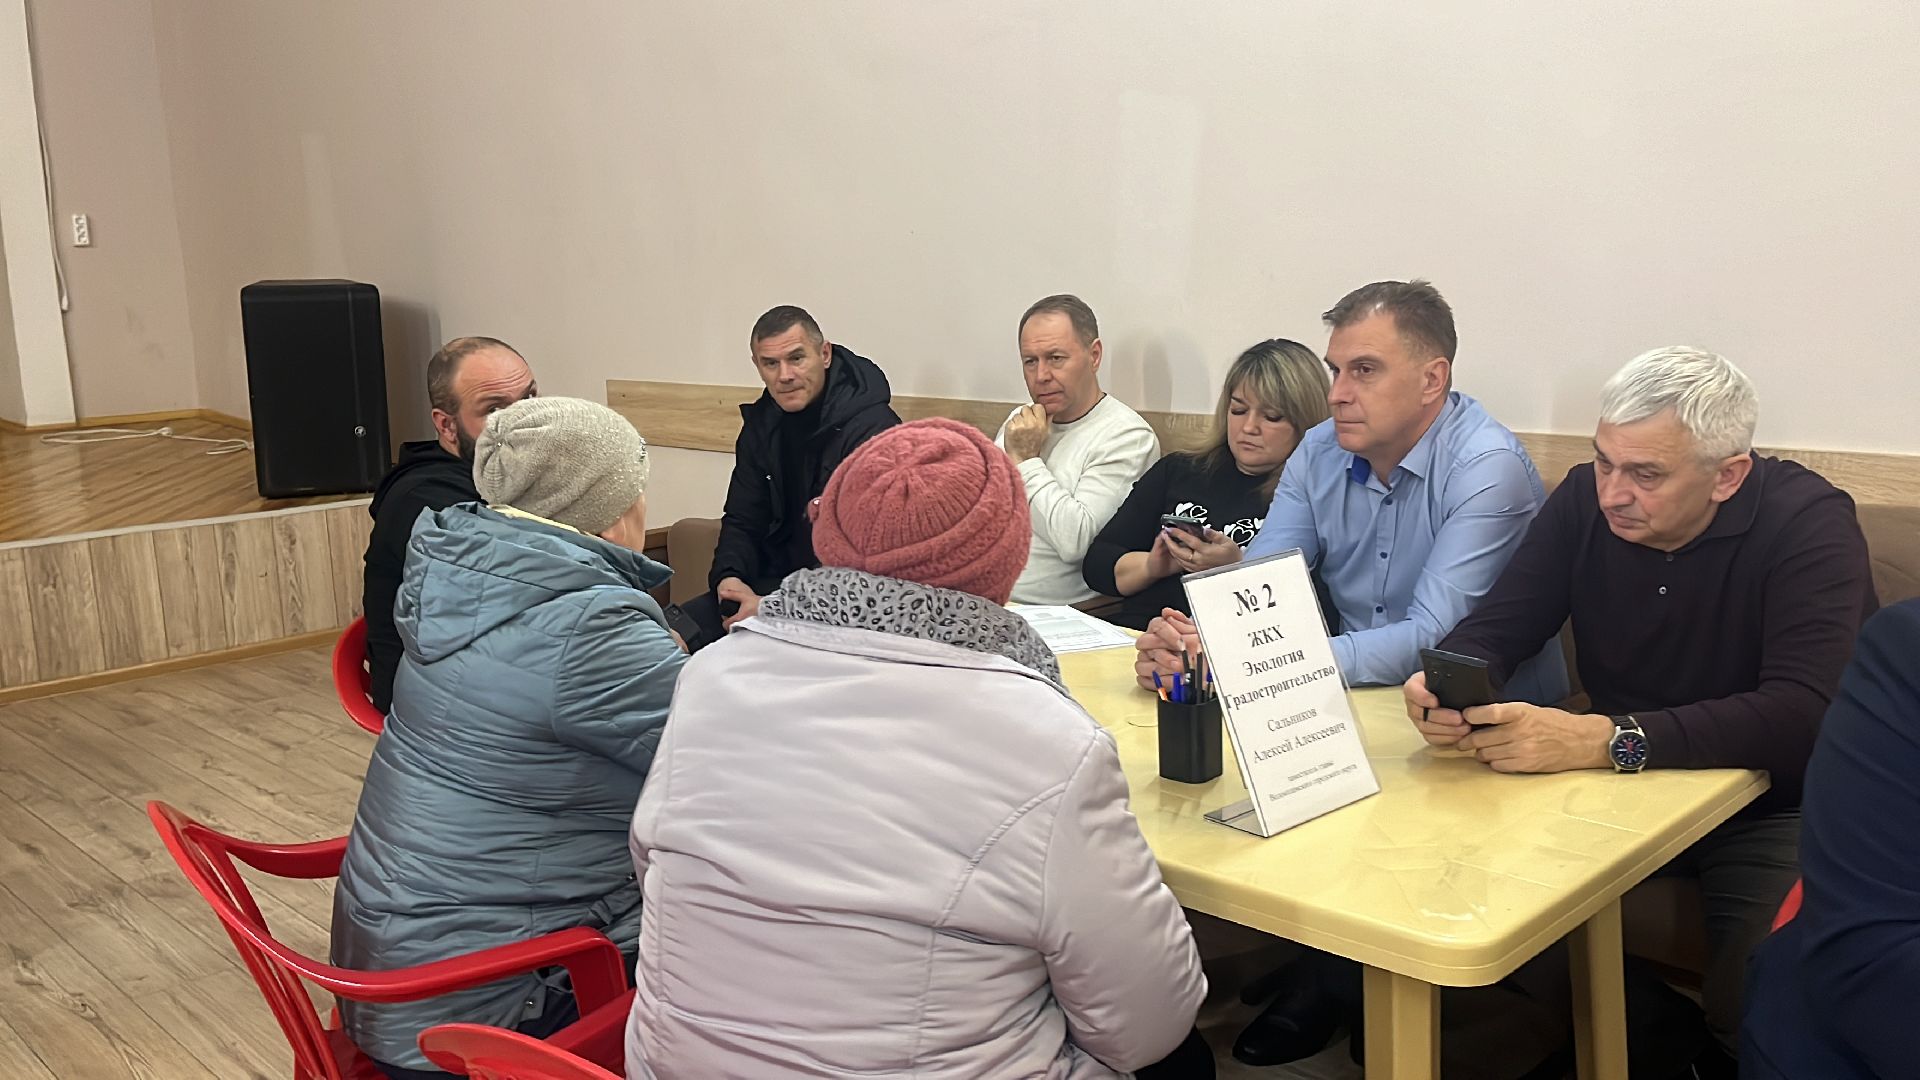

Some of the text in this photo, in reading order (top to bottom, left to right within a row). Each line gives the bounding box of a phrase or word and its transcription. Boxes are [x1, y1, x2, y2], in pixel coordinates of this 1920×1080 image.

[1233, 583, 1276, 616] № 2
[1248, 624, 1284, 648] ЖКХ
[1242, 649, 1305, 677] Экология
[1224, 665, 1336, 710] Градостроительство
[1267, 708, 1318, 732] Сальников
[1254, 738, 1294, 764] Алексей
